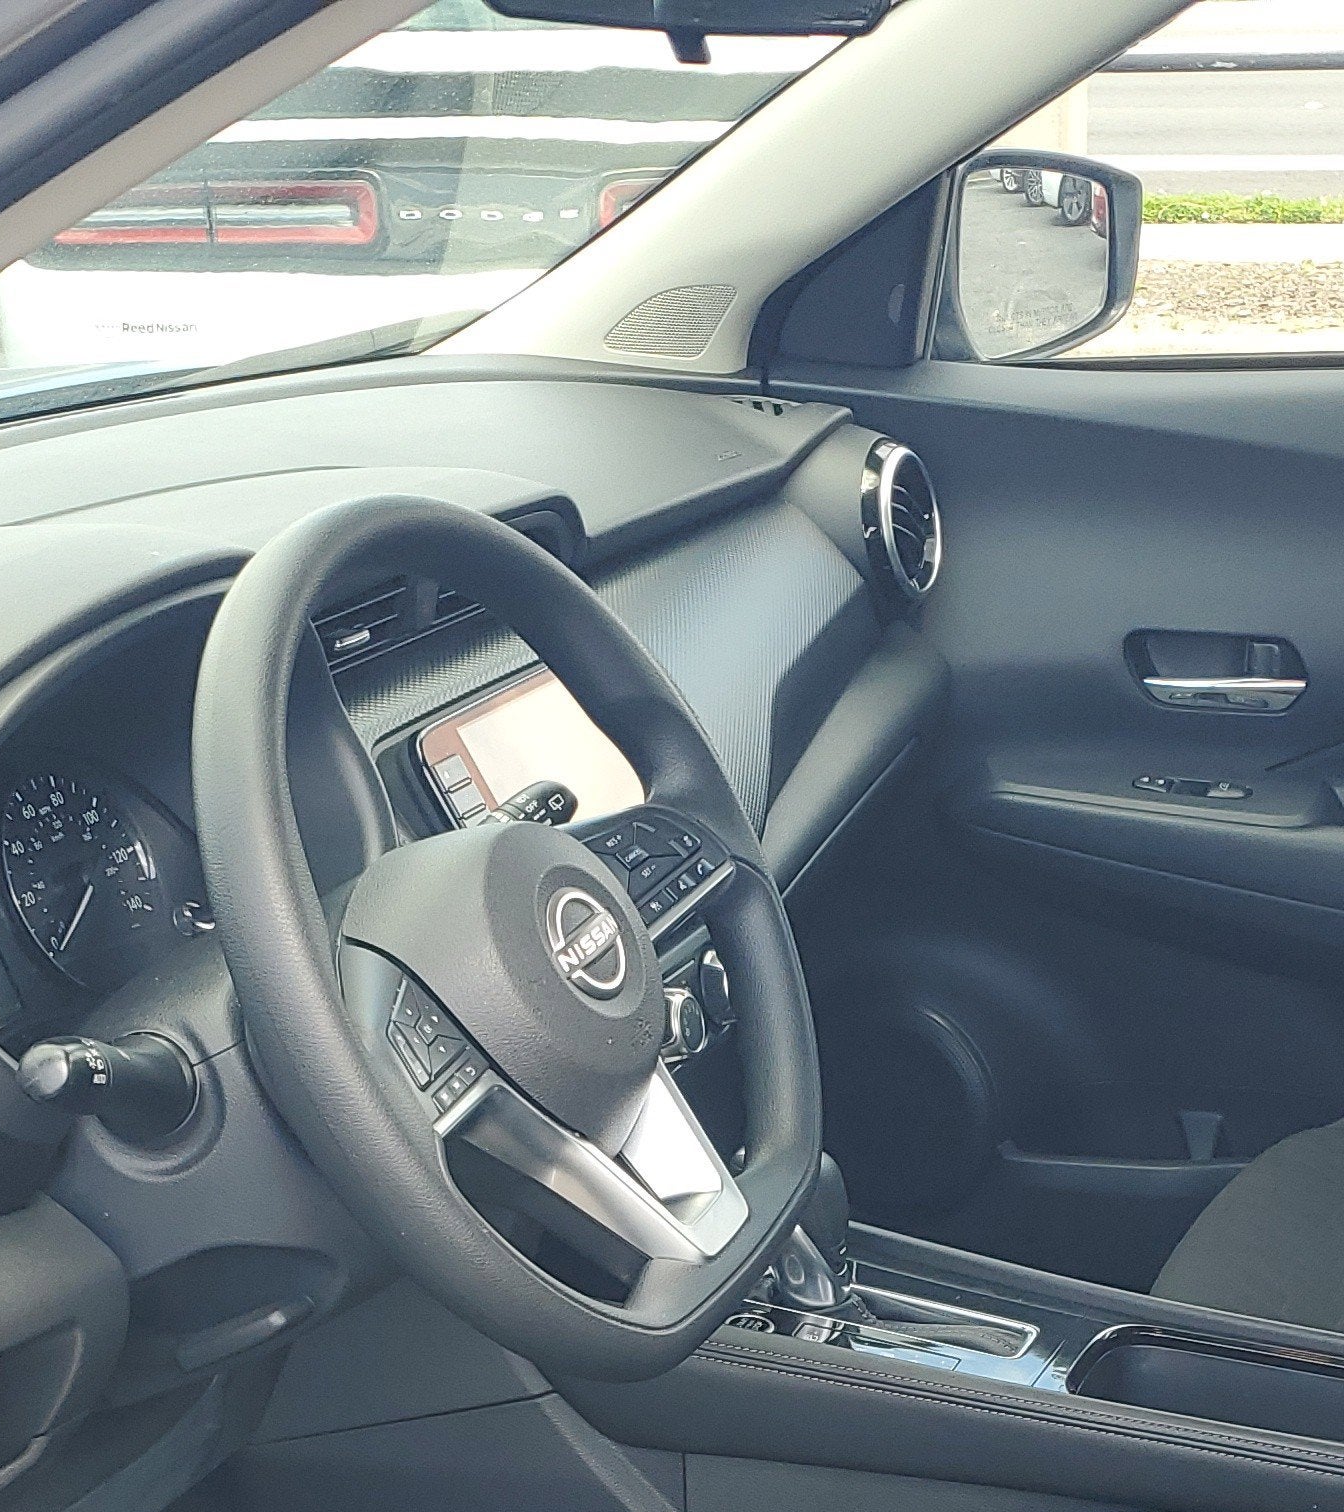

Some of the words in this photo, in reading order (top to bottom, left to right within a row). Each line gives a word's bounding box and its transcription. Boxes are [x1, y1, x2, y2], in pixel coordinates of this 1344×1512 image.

[49, 791, 64, 807] 80
[22, 803, 36, 819] 60
[82, 809, 99, 826] 100
[10, 840, 25, 856] 40
[112, 847, 129, 864] 120
[21, 891, 36, 907] 20
[126, 895, 143, 914] 140
[557, 913, 619, 973] NISSAN
